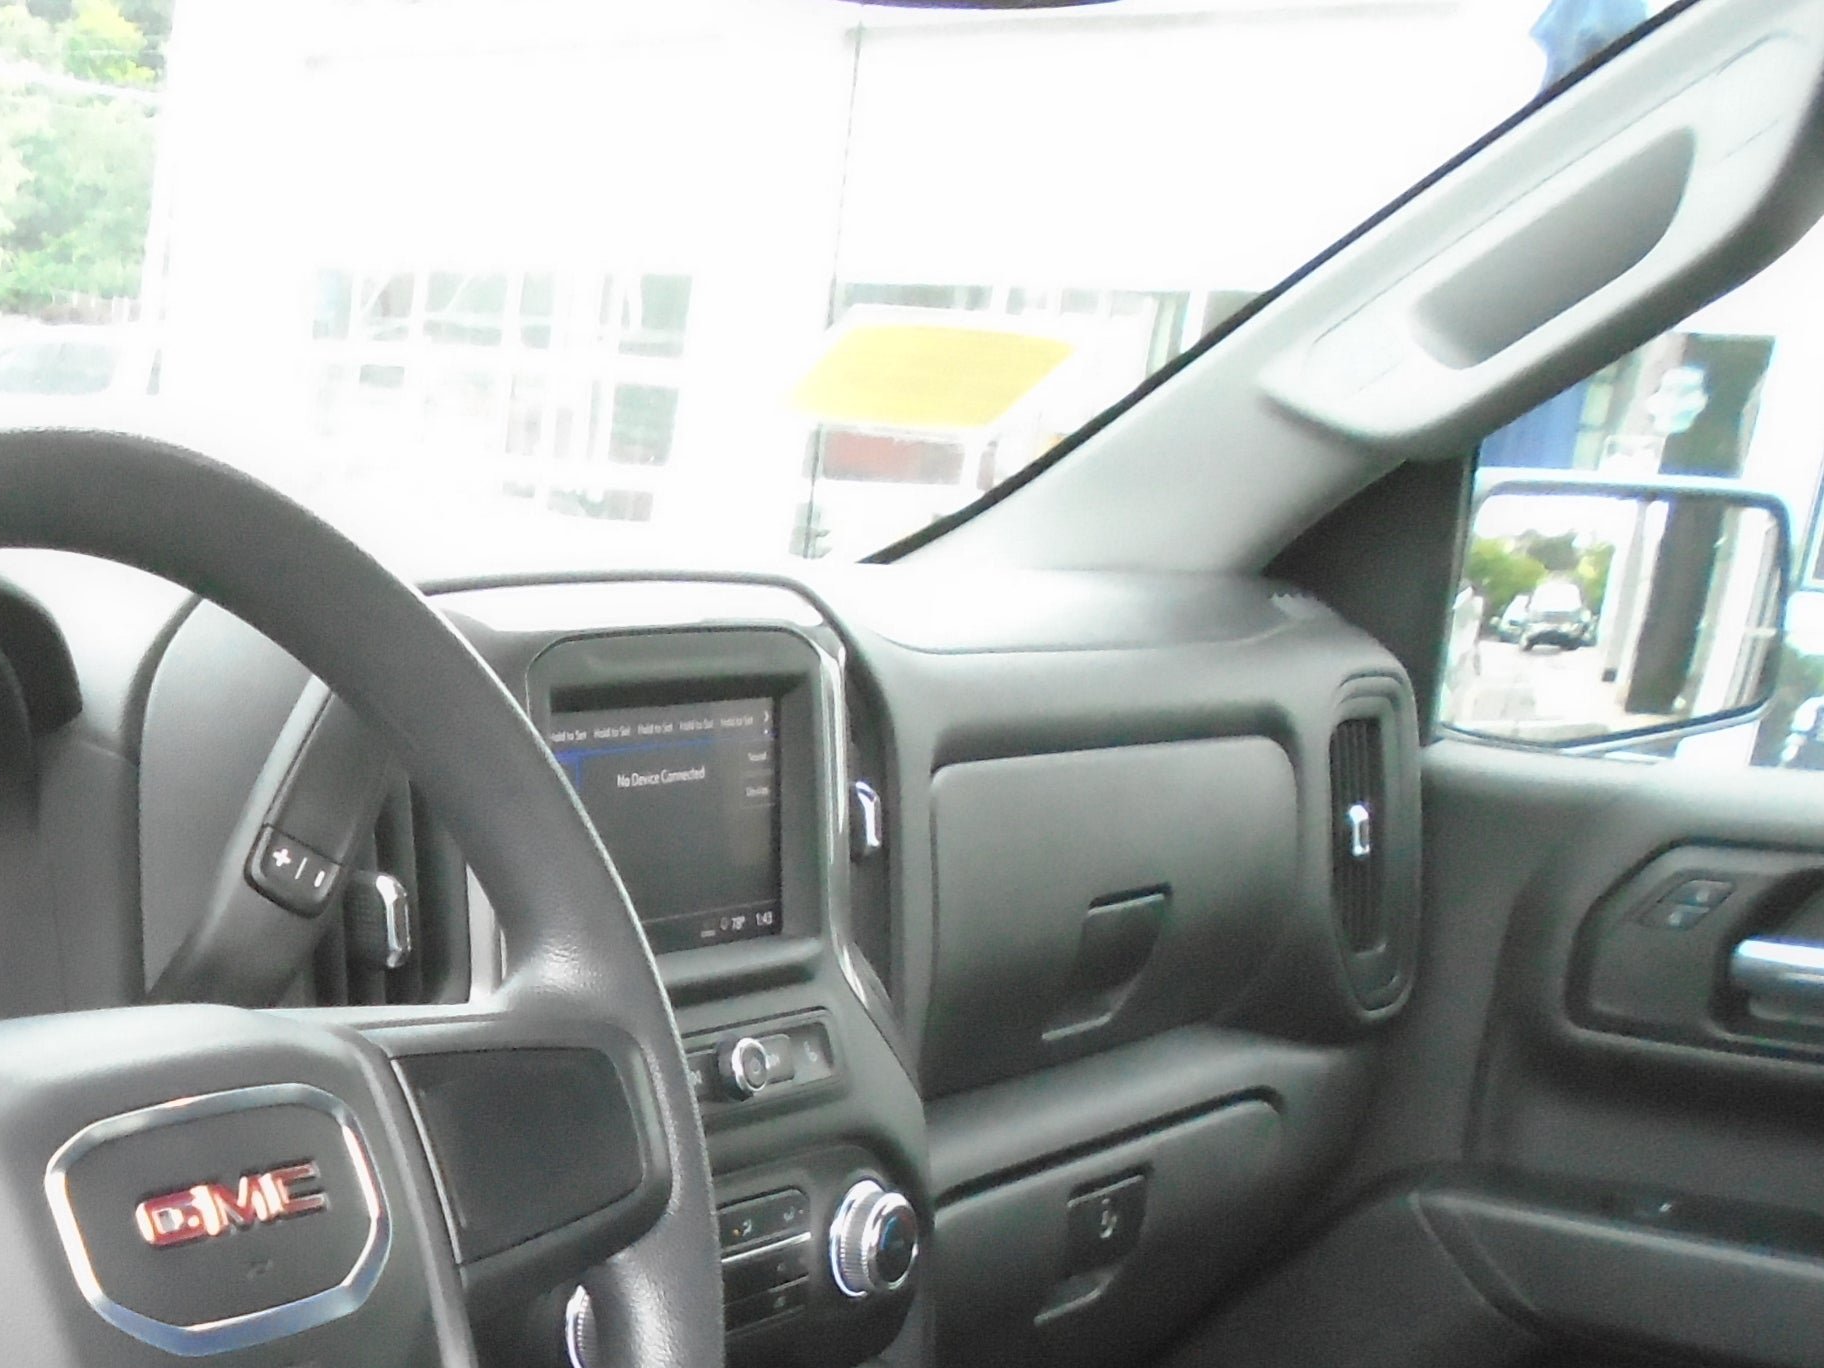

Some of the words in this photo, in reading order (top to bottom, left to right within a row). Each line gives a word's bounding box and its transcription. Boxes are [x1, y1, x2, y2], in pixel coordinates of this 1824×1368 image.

[617, 774, 630, 788] No
[631, 772, 660, 787] Device
[661, 764, 705, 784] Connected
[134, 1159, 330, 1248] GMC
